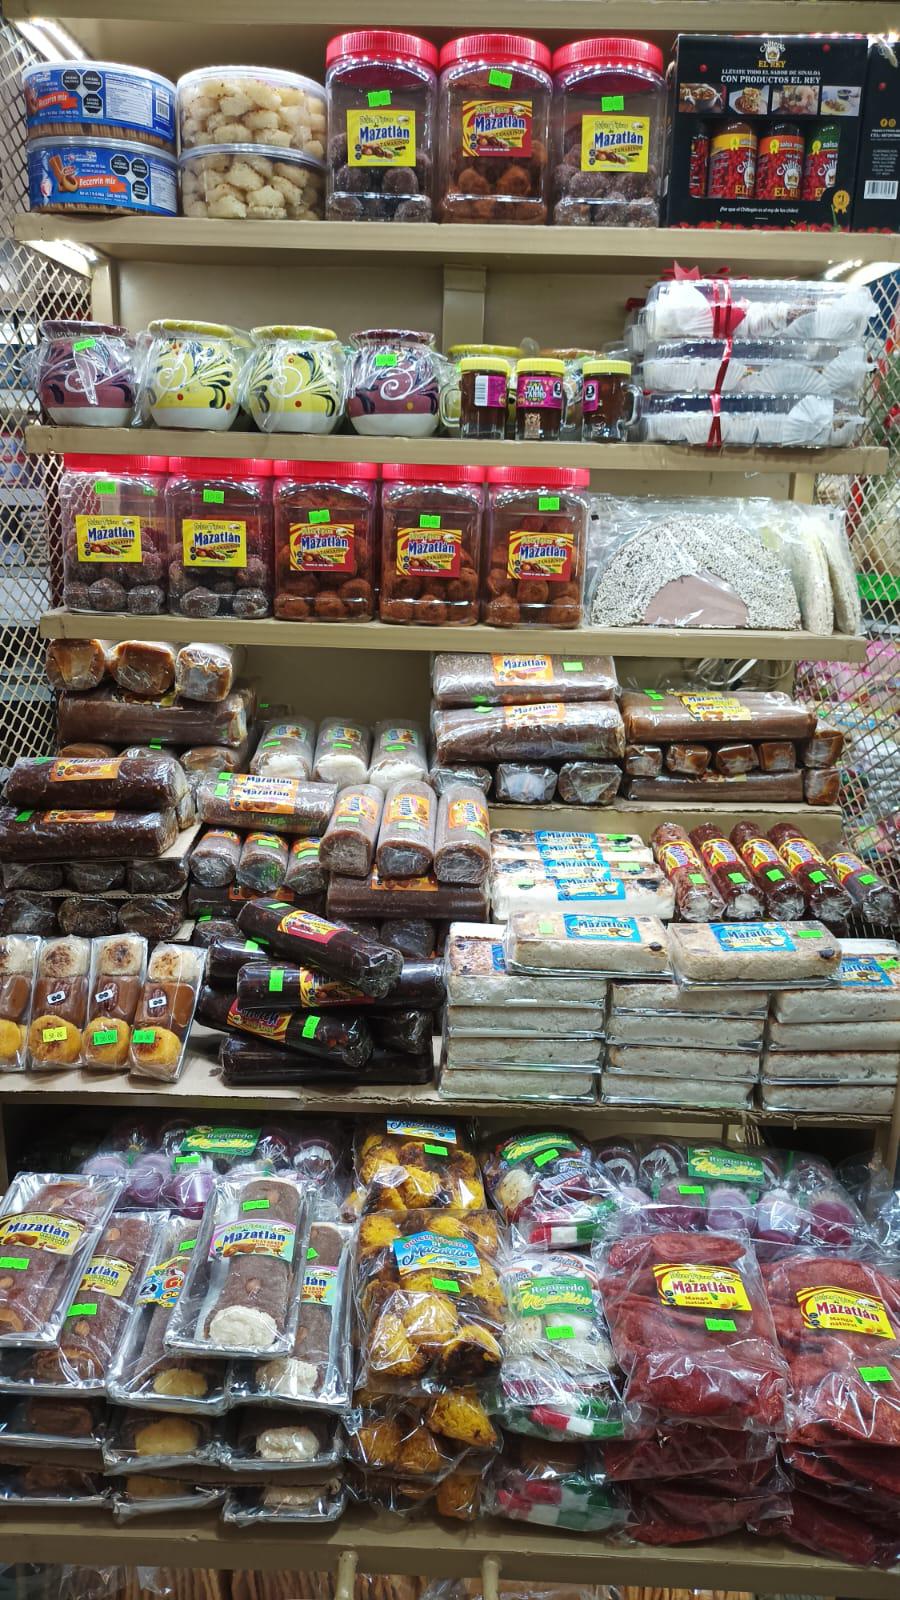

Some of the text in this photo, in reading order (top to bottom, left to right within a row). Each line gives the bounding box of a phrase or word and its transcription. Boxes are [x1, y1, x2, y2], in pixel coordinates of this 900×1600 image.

[759, 60, 786, 68] EL REY
[721, 75, 821, 84] CON PRODUCTOS EL REY
[359, 125, 410, 143] Mazatlán
[594, 130, 644, 148] Mazatlán
[87, 526, 135, 542] Mazatlán
[194, 531, 241, 546] Mazatlán
[301, 535, 348, 550] Mazatlán
[408, 541, 455, 556] Mazatlán
[520, 545, 567, 560] Mazatlán
[6, 1222, 71, 1239] Mazatlán
[222, 1230, 286, 1246] Mazatlán
[531, 1283, 585, 1294] Recuerdo
[672, 1280, 736, 1295] Mazatlán
[816, 1301, 880, 1322] Mazatlán
